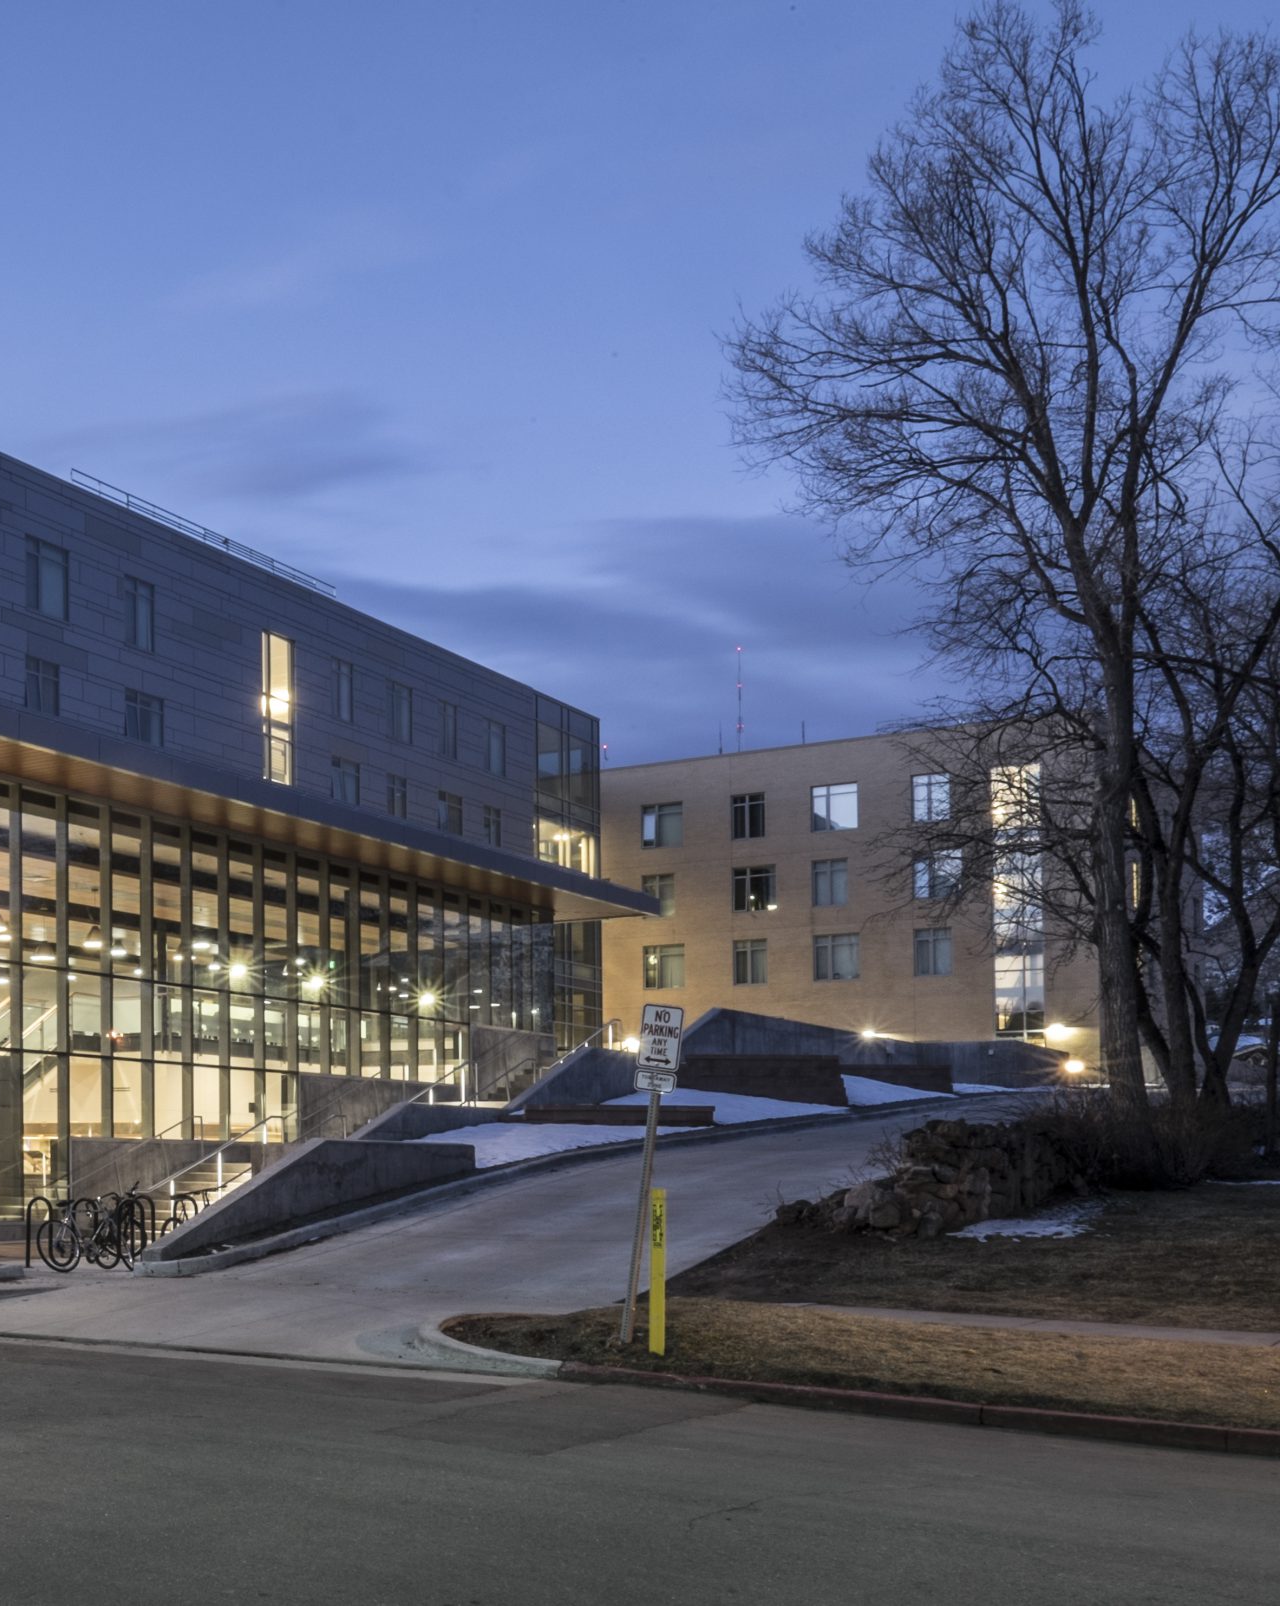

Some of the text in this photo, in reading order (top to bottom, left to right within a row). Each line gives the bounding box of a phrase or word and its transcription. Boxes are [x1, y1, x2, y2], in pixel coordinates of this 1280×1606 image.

[655, 1010, 671, 1023] NO
[643, 1023, 679, 1039] PARKING
[651, 1038, 668, 1047] ANY
[650, 1047, 668, 1057] TIME
